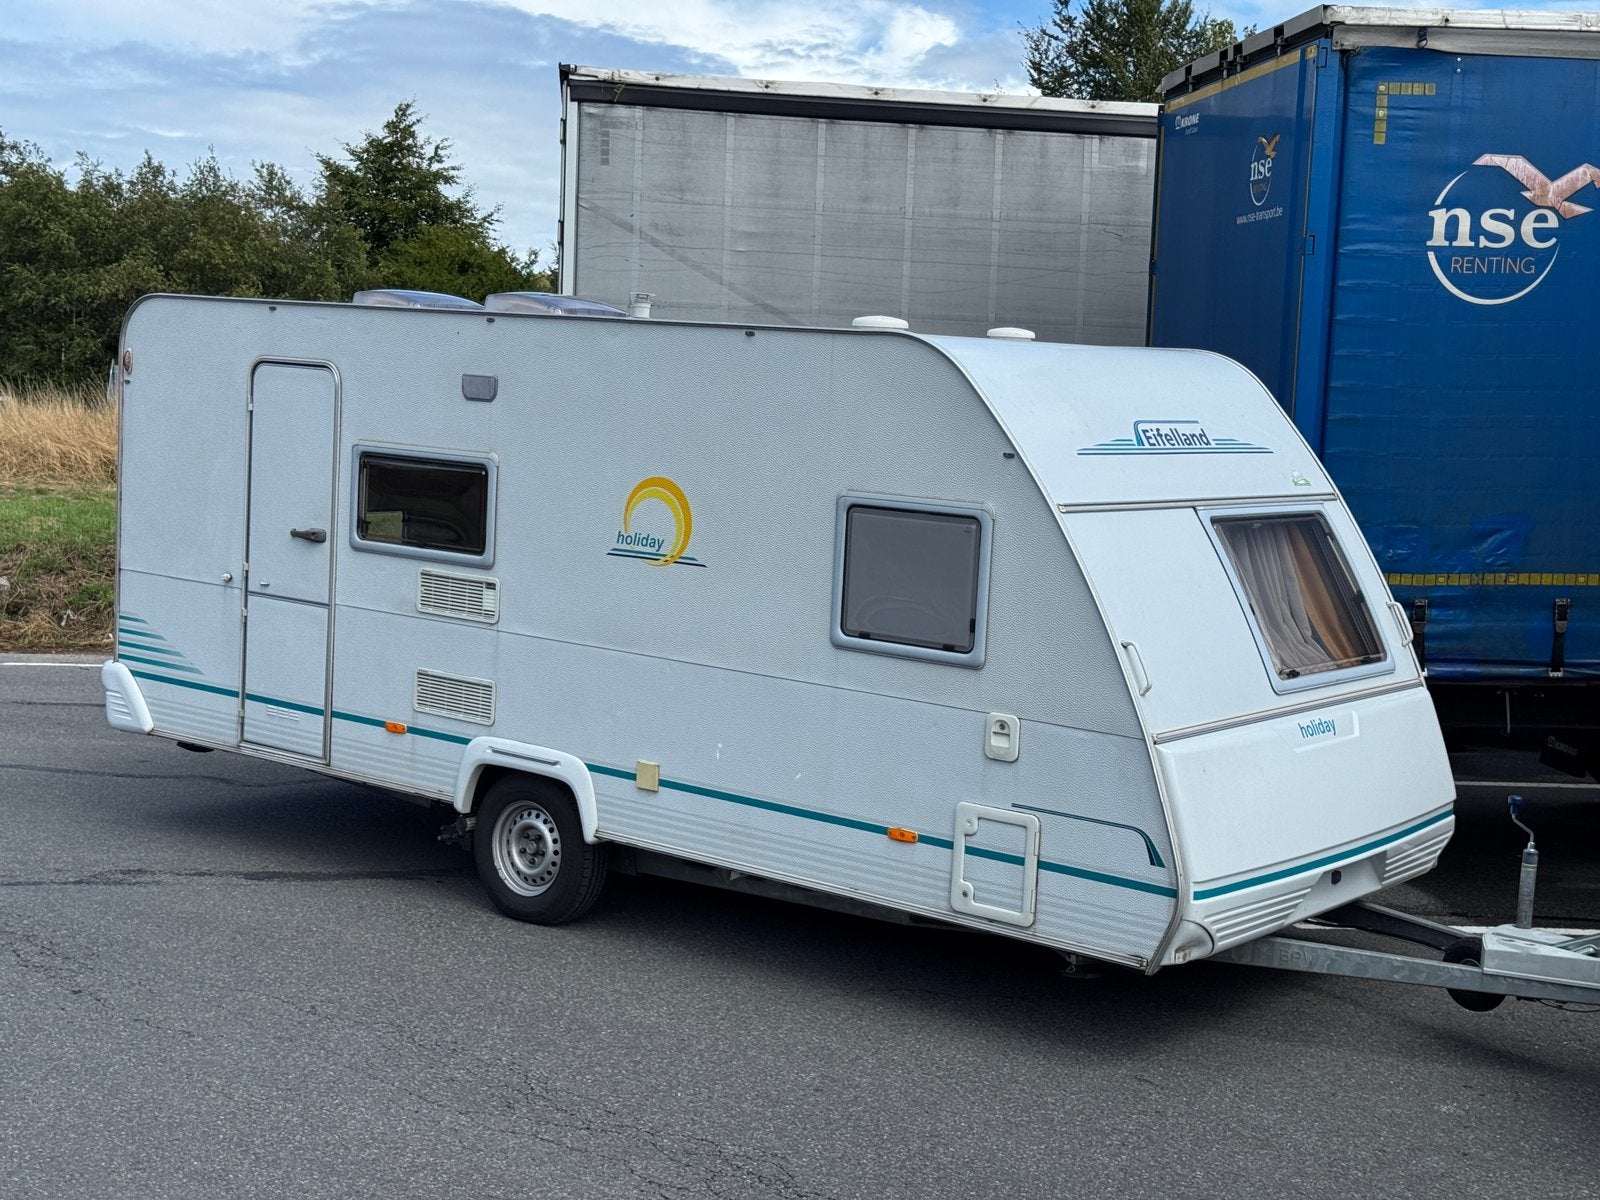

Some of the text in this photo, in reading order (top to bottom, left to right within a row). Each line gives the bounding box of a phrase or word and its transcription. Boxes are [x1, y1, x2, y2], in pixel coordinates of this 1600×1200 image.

[1250, 158, 1273, 181] nse
[1426, 208, 1559, 248] nse
[1450, 257, 1535, 274] RENTING
[1141, 427, 1212, 446] Eifelland
[616, 530, 665, 552] holiday
[1297, 717, 1337, 739] holiday
